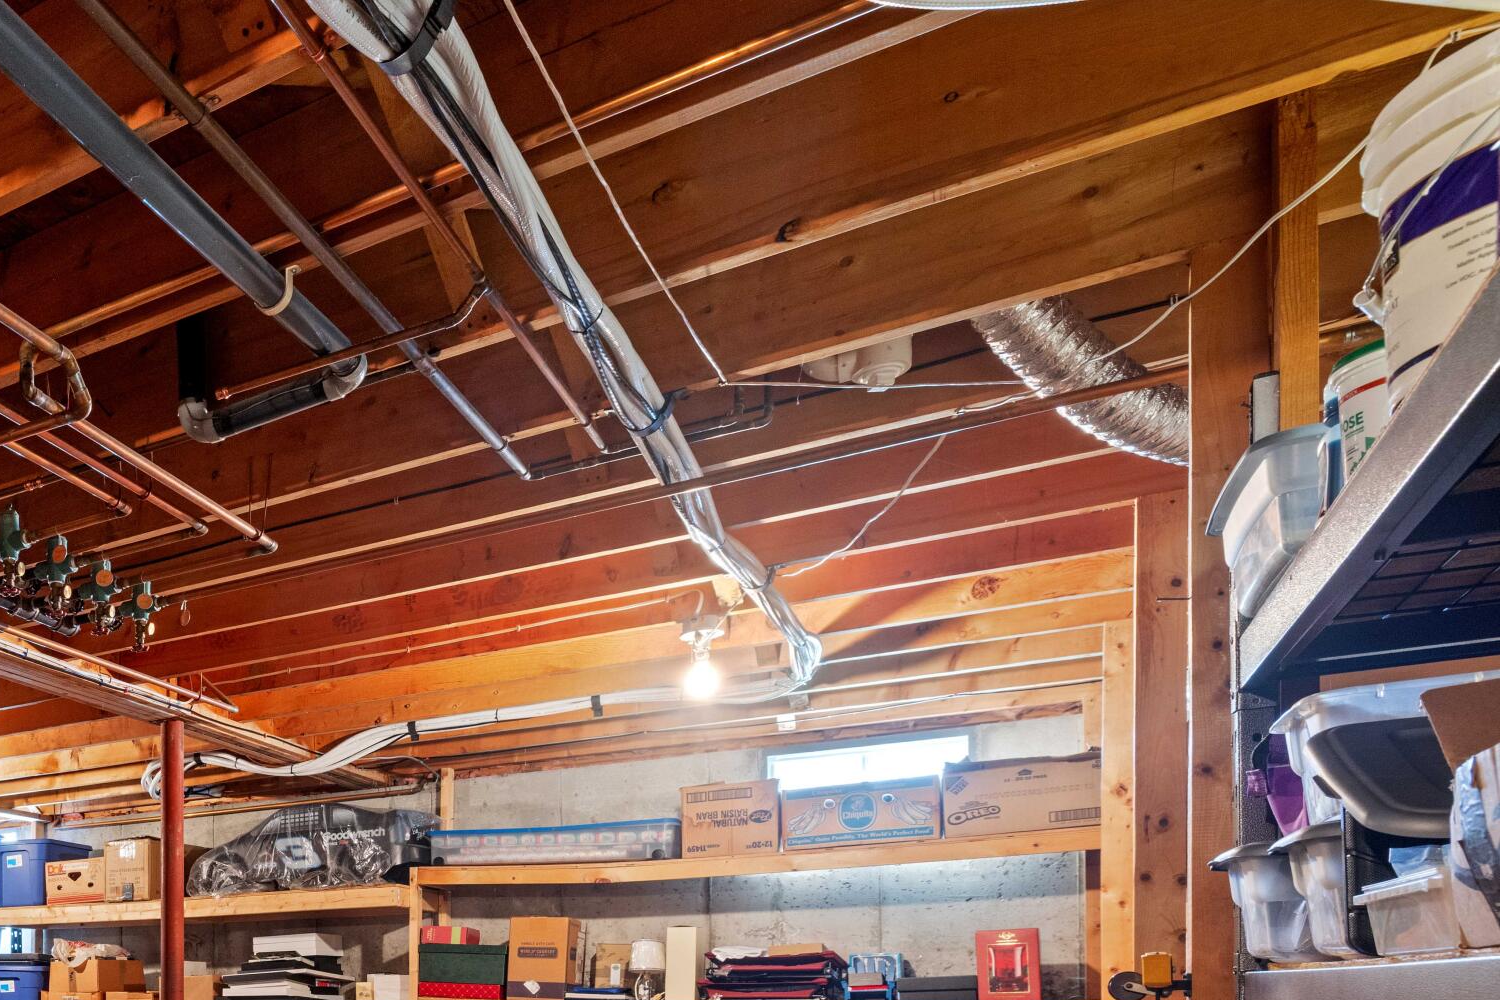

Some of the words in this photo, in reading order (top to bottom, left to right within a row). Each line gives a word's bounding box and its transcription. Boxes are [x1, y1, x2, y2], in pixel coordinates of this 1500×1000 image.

[696, 811, 718, 820] BRAN
[721, 809, 748, 819] RAISIN
[842, 810, 873, 820] Chiquita
[948, 805, 1001, 825] OREO
[713, 819, 748, 828] NATURAL
[322, 827, 386, 842] Goodwrench
